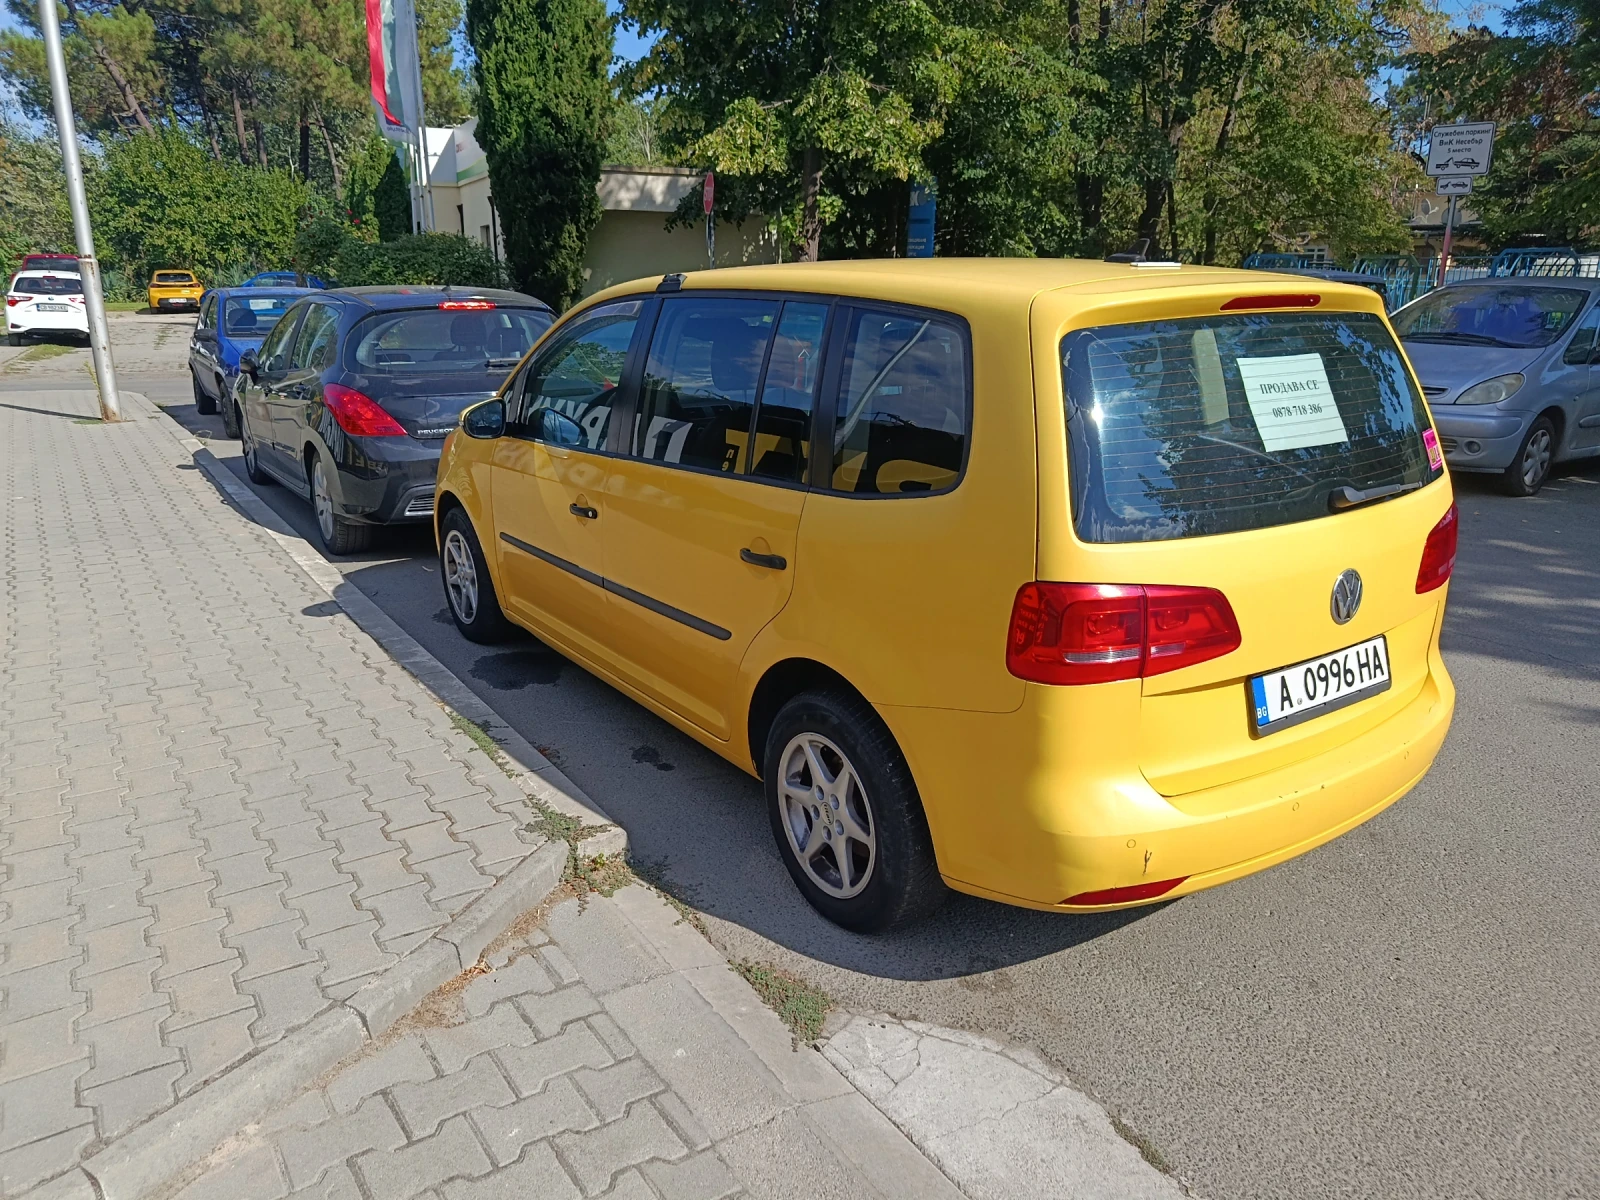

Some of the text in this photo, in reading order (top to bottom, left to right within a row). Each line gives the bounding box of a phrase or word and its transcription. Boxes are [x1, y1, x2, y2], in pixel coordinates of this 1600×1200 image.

[1434, 130, 1464, 138] Служебен
[1259, 379, 1320, 394] ПРОДАВА СЕ
[1272, 403, 1323, 418] 0878 718 386
[1280, 645, 1385, 711] A 0996 HA
[1257, 706, 1268, 719] BG
